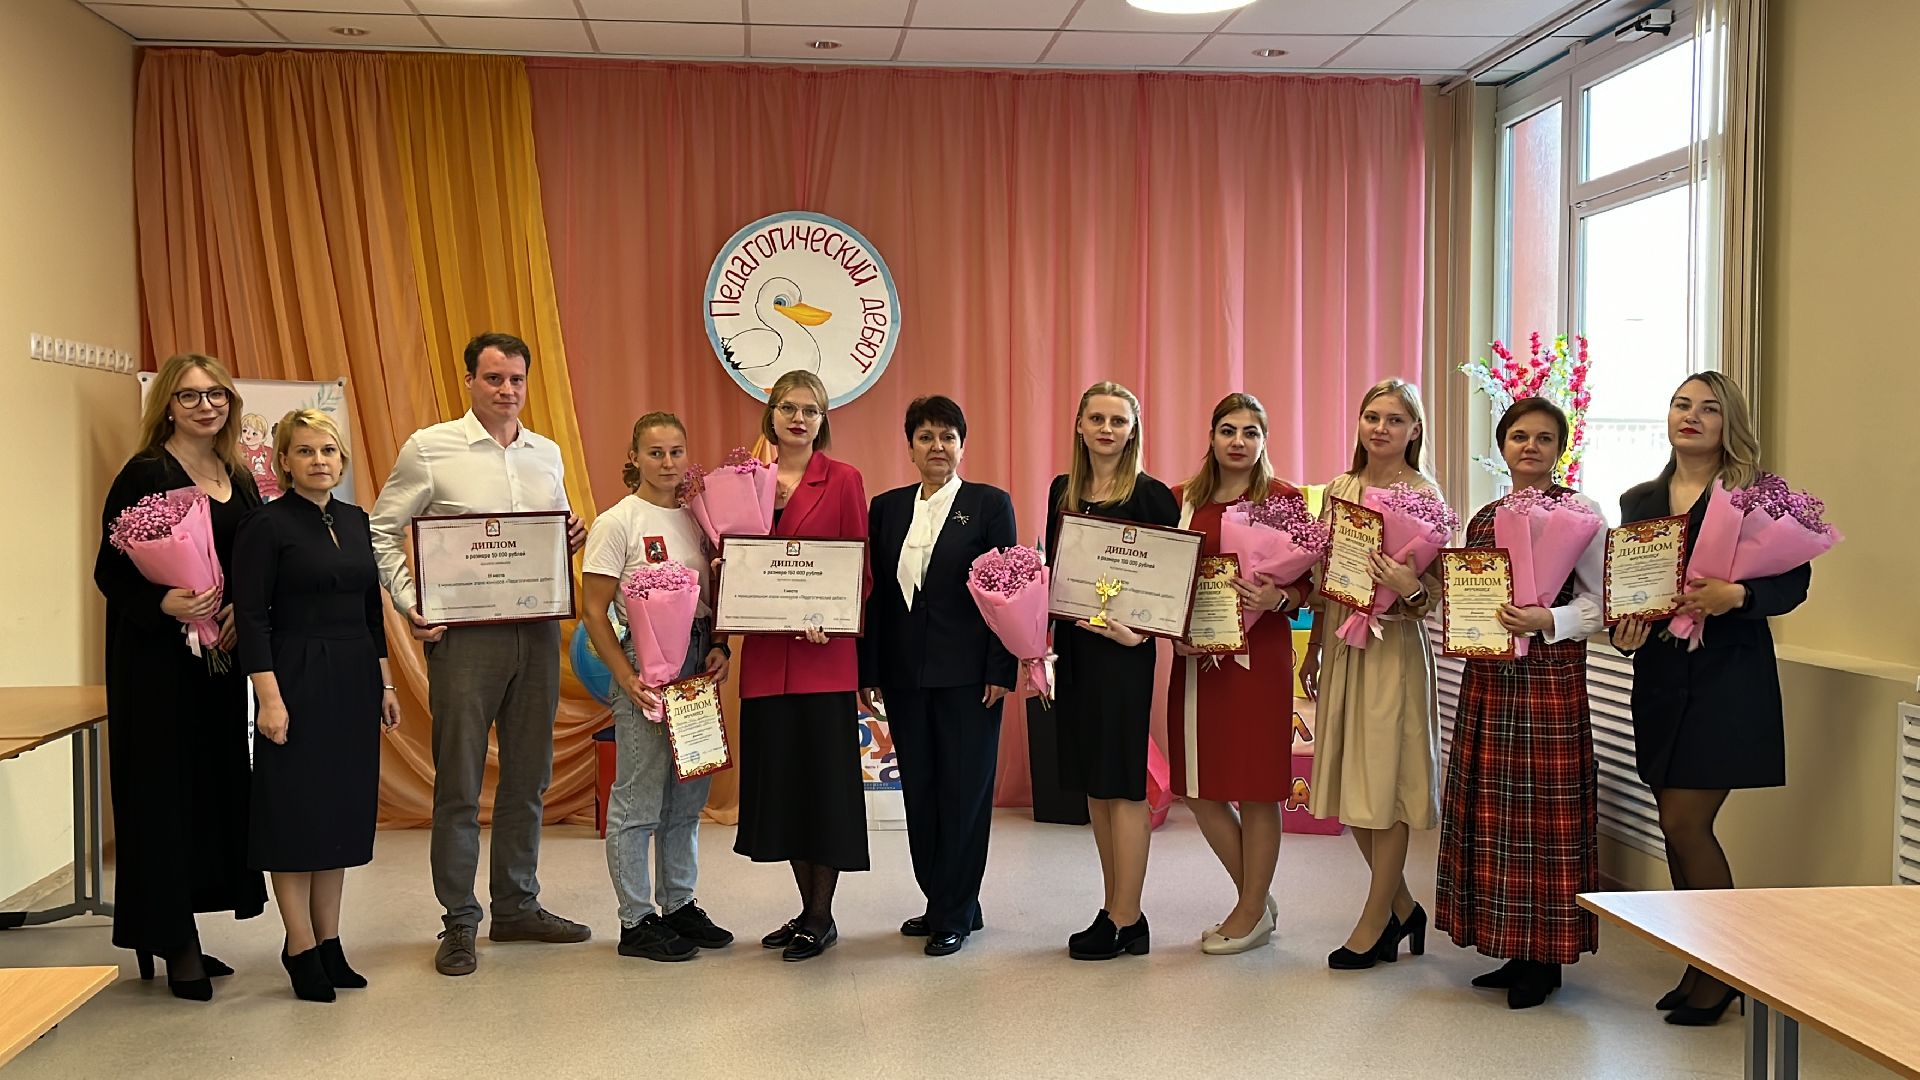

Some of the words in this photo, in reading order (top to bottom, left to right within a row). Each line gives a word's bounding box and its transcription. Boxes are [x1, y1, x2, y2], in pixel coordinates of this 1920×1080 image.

[709, 225, 877, 317] Педагогический
[1339, 525, 1375, 545] ДИПЛОМ
[471, 540, 517, 551] ДИПЛОМ
[1104, 545, 1148, 559] ДИПЛОМ
[1617, 542, 1673, 558] ДИПЛОМ
[770, 560, 814, 568] ДИПЛОМ
[1198, 581, 1233, 590] ИПЛОМ
[1453, 577, 1502, 587] ДИПЛОМ
[674, 699, 712, 717] ДИПЛОМ
